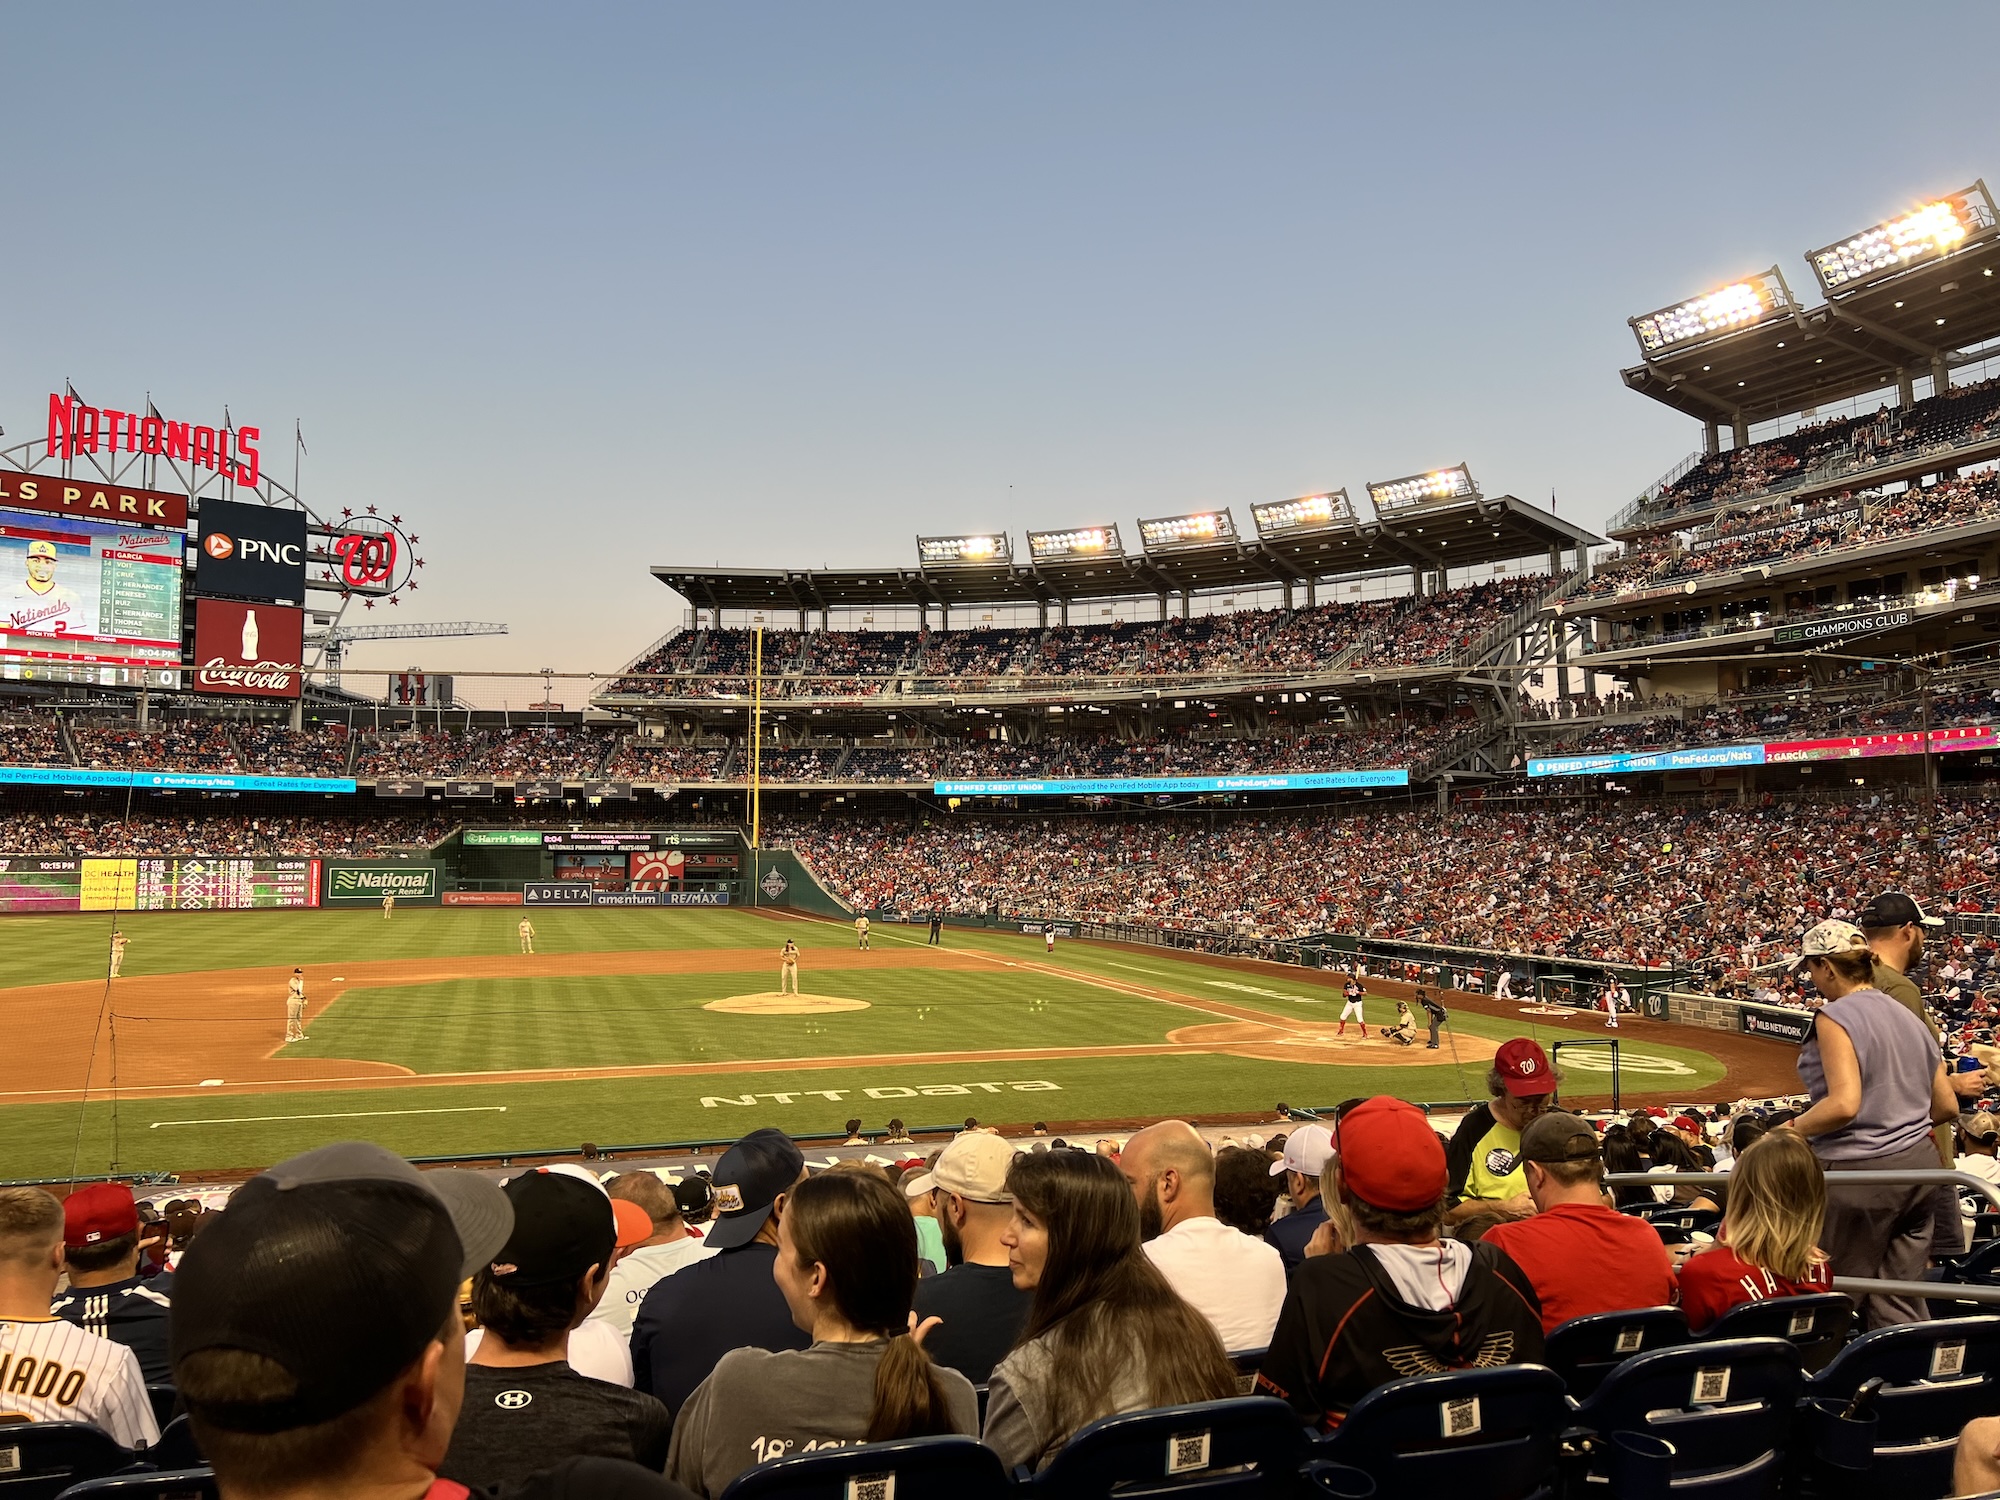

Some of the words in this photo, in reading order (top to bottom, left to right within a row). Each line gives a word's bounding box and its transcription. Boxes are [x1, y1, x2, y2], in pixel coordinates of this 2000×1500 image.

[47, 393, 260, 488] NATIONALS
[63, 487, 166, 518] PARK
[118, 533, 170, 549] Nationals
[117, 551, 143, 560] GARCÍA
[238, 537, 301, 566] PNC
[335, 532, 397, 586] W
[10, 599, 70, 628] Nationals
[114, 619, 143, 627] THOMAS
[1805, 618, 1873, 637] CHAMPIONS
[1875, 613, 1908, 627] CLUB
[114, 628, 142, 636] VARGAS
[138, 648, 160, 657] 8:04
[162, 650, 175, 658] PM
[47, 672, 51, 680] 1
[68, 673, 72, 681] 1
[86, 674, 93, 682] 5
[122, 668, 128, 682] 1
[160, 671, 173, 685] 0
[1976, 728, 1981, 736] 9
[1672, 751, 1752, 764] PenFed.org/Nats
[1774, 750, 1808, 761] GARCÍA
[1547, 762, 1583, 771] PENFED
[15, 772, 50, 780] PenFed
[85, 775, 104, 783] App
[164, 777, 235, 786] PenFed.org/Nats
[1305, 777, 1324, 785] Great
[1325, 776, 1346, 784] Rates
[1360, 775, 1395, 784] Everyone
[314, 782, 348, 790] Everyone
[1096, 782, 1107, 790] the
[1109, 782, 1136, 790] PenFed
[1163, 782, 1178, 790] App
[1226, 779, 1288, 788] PenFed.org/Nats
[478, 835, 507, 843] Harris
[510, 835, 539, 843] Teeter
[357, 873, 428, 888] National
[543, 889, 589, 899] DELTA
[671, 894, 718, 904] RE/MAX
[598, 895, 656, 904] amentum
[1756, 1020, 1769, 1030] MLB
[1769, 1022, 1802, 1037] NETWORK
[1520, 1057, 1535, 1075] W
[700, 1089, 851, 1108] NTT
